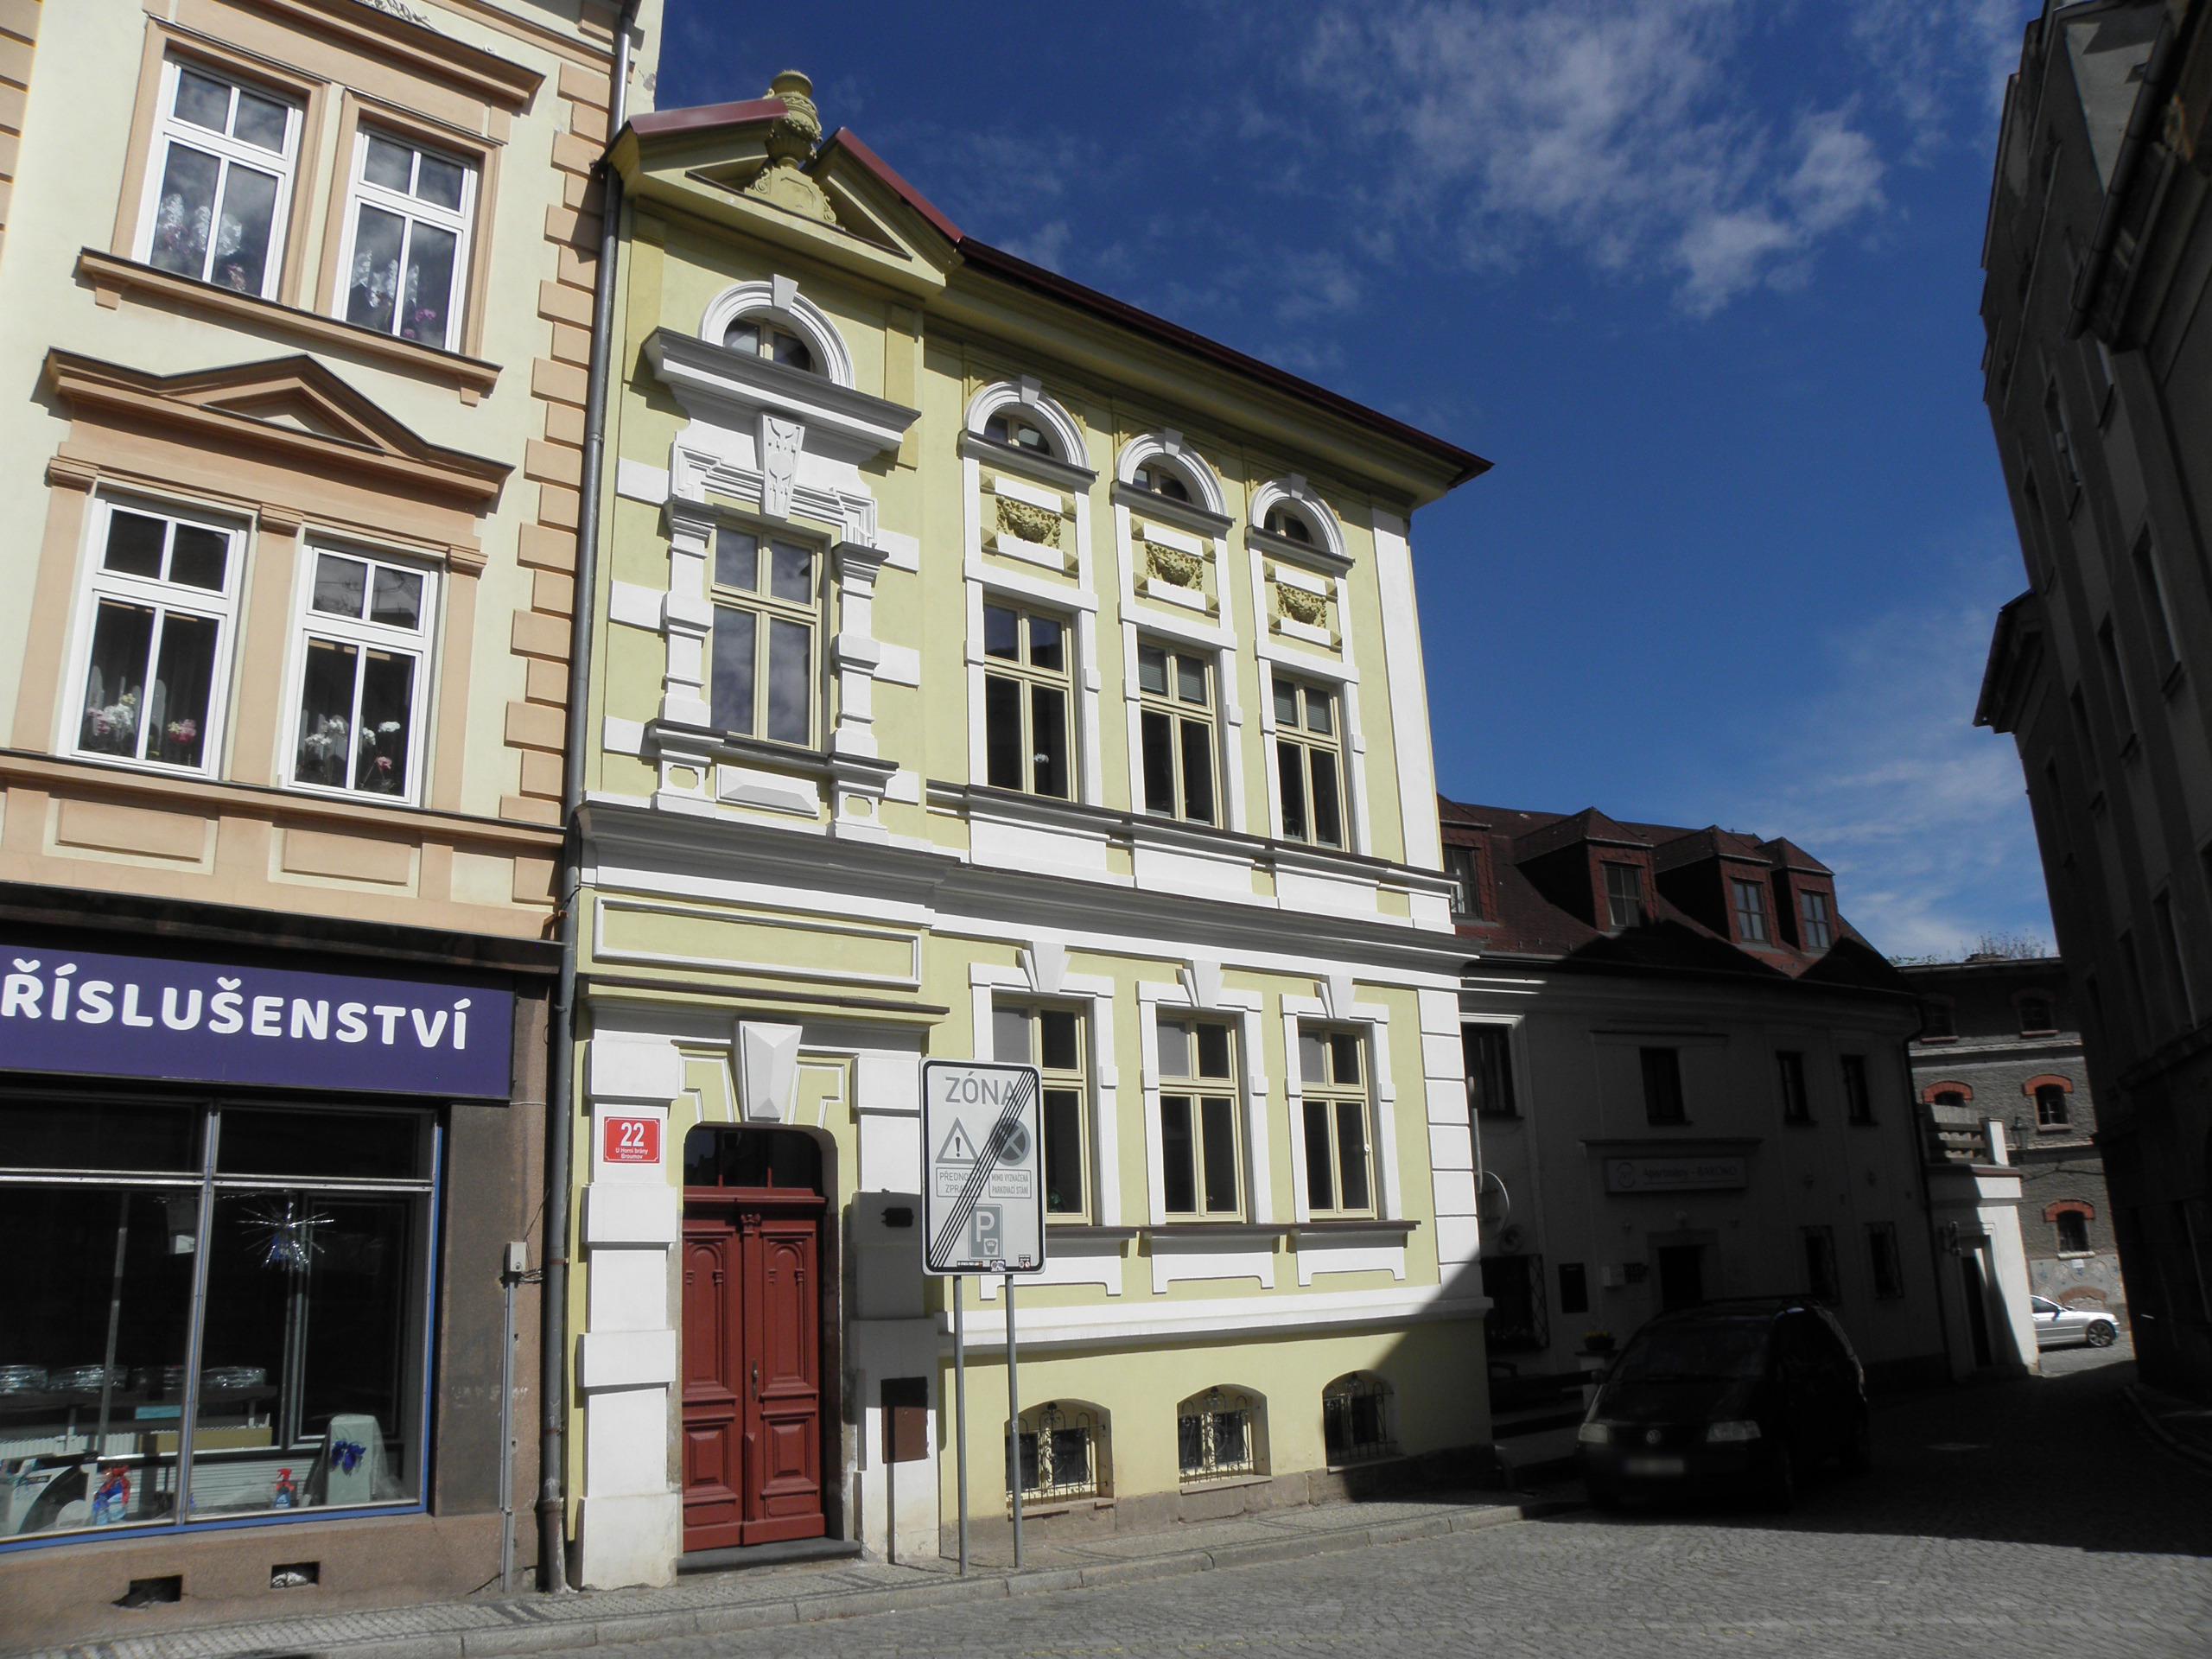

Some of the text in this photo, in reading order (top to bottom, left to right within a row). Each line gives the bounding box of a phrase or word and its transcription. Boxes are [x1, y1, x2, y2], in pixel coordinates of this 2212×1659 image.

[1, 957, 472, 1050] ŘÍSLUŠENSTVÍ
[945, 1071, 1019, 1105] ZÓNA
[620, 1122, 645, 1147] 22
[976, 1211, 995, 1242] P
